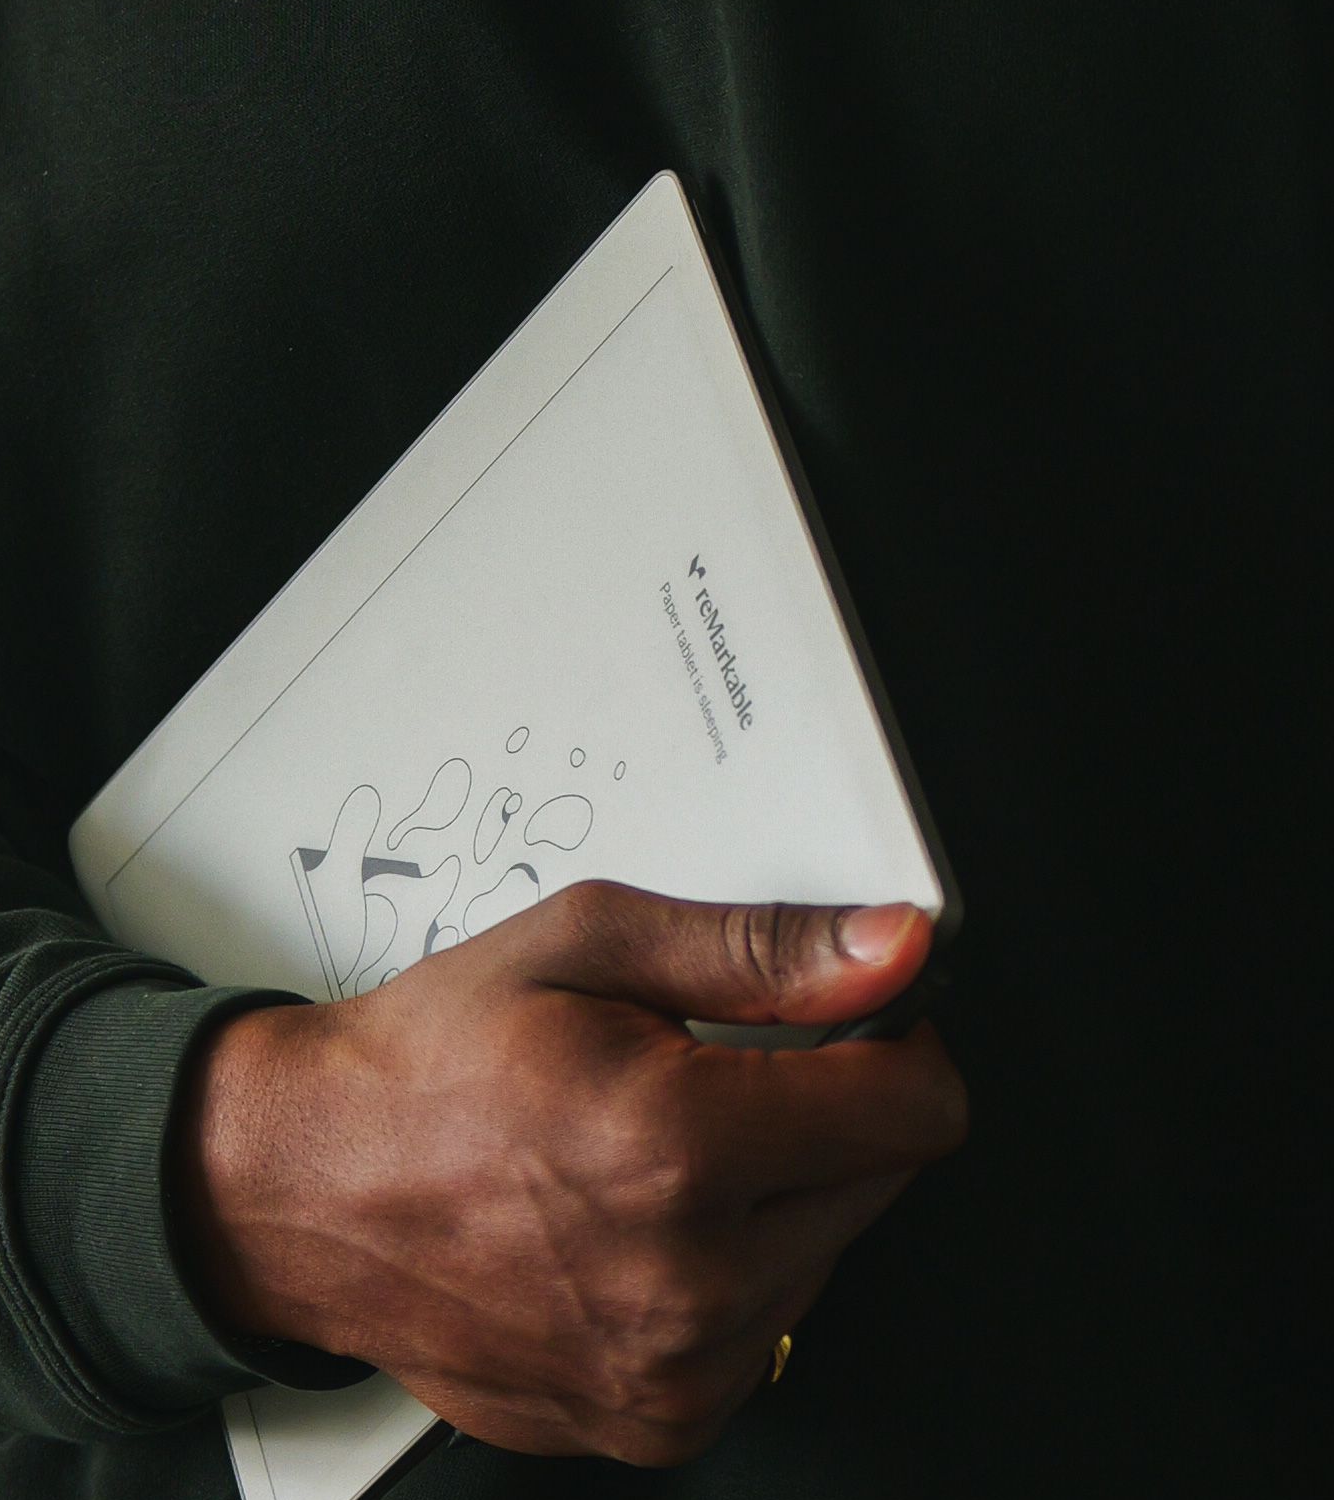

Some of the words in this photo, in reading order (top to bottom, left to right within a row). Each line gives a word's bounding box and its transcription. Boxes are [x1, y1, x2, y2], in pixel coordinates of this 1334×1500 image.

[659, 581, 681, 630] Paper
[676, 629, 699, 680] tablet
[695, 587, 753, 731] reMarkable
[693, 675, 704, 695] is
[698, 695, 728, 765] sleeping
